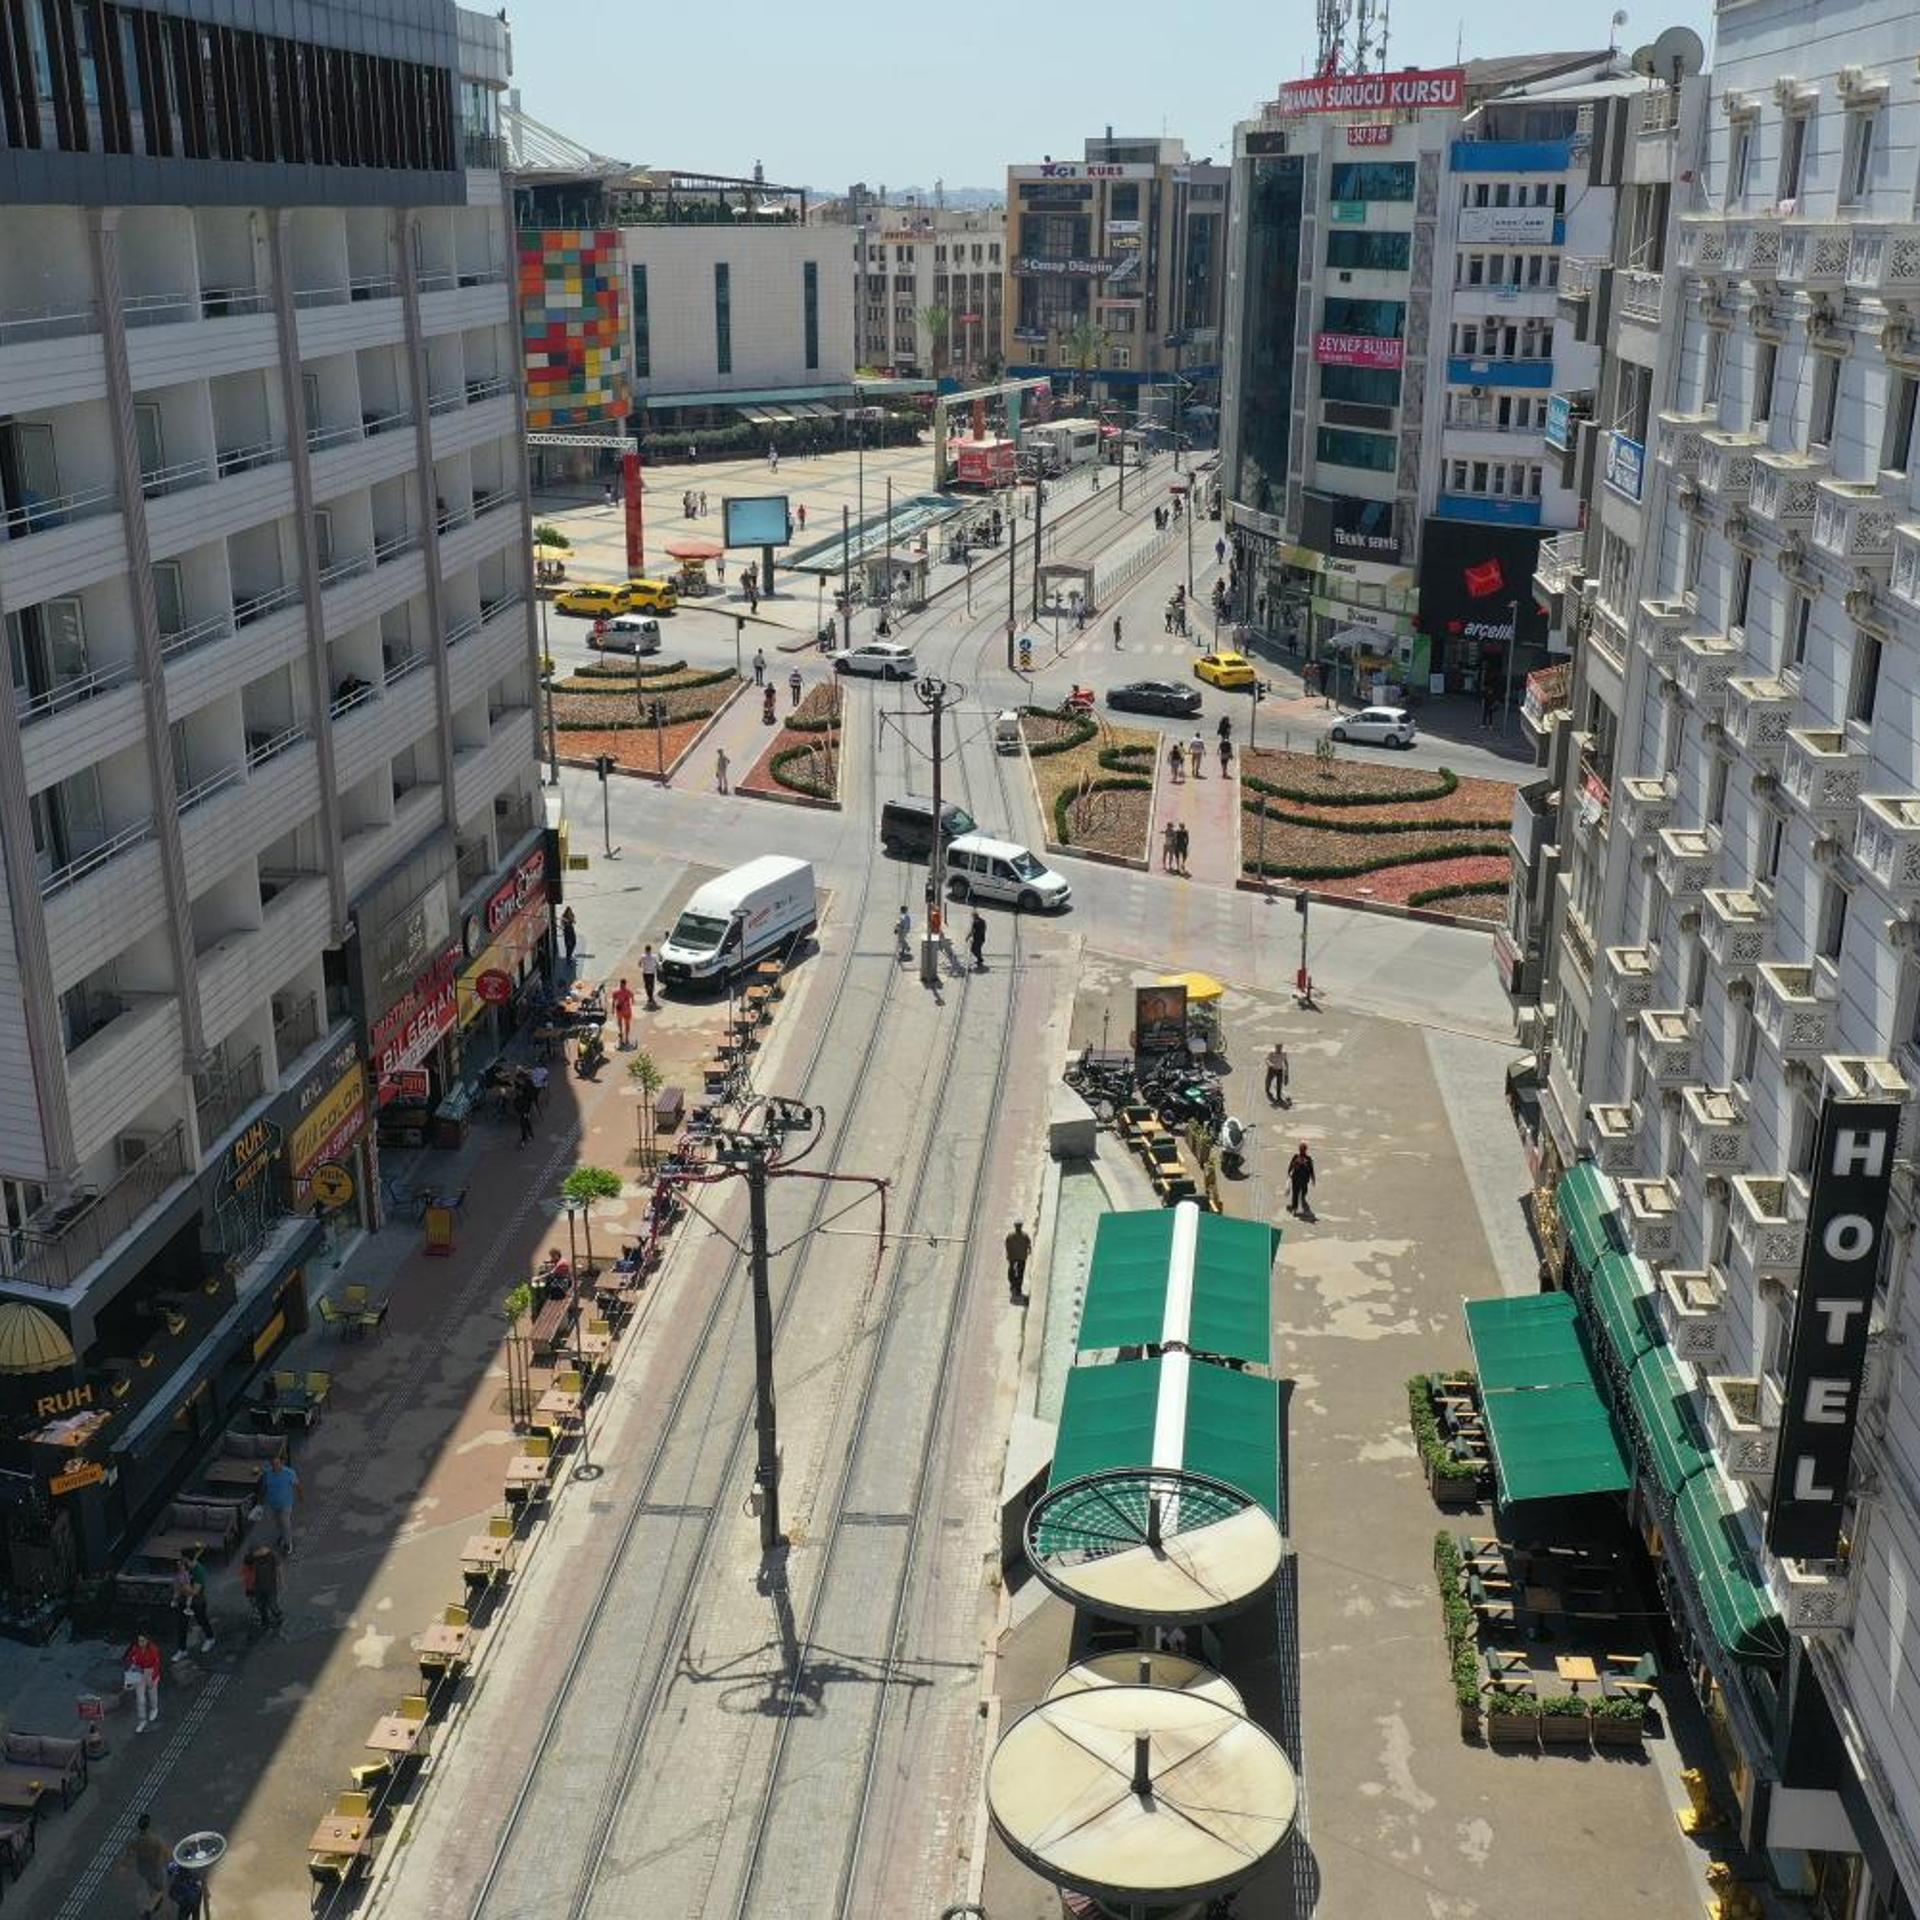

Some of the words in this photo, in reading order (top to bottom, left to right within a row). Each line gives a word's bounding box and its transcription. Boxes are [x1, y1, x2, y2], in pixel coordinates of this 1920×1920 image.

[1326, 76, 1386, 108] SÜRÜCÜ
[1390, 79, 1457, 104] KURSU
[1087, 165, 1124, 176] KURS
[1318, 337, 1361, 352] ZEYNEP
[1363, 338, 1401, 355] BULUT
[383, 978, 457, 1074] BİLGEHAN
[235, 1120, 266, 1163] RUH
[1793, 1128, 1887, 1502] HOTEL
[37, 1383, 93, 1417] RUH
